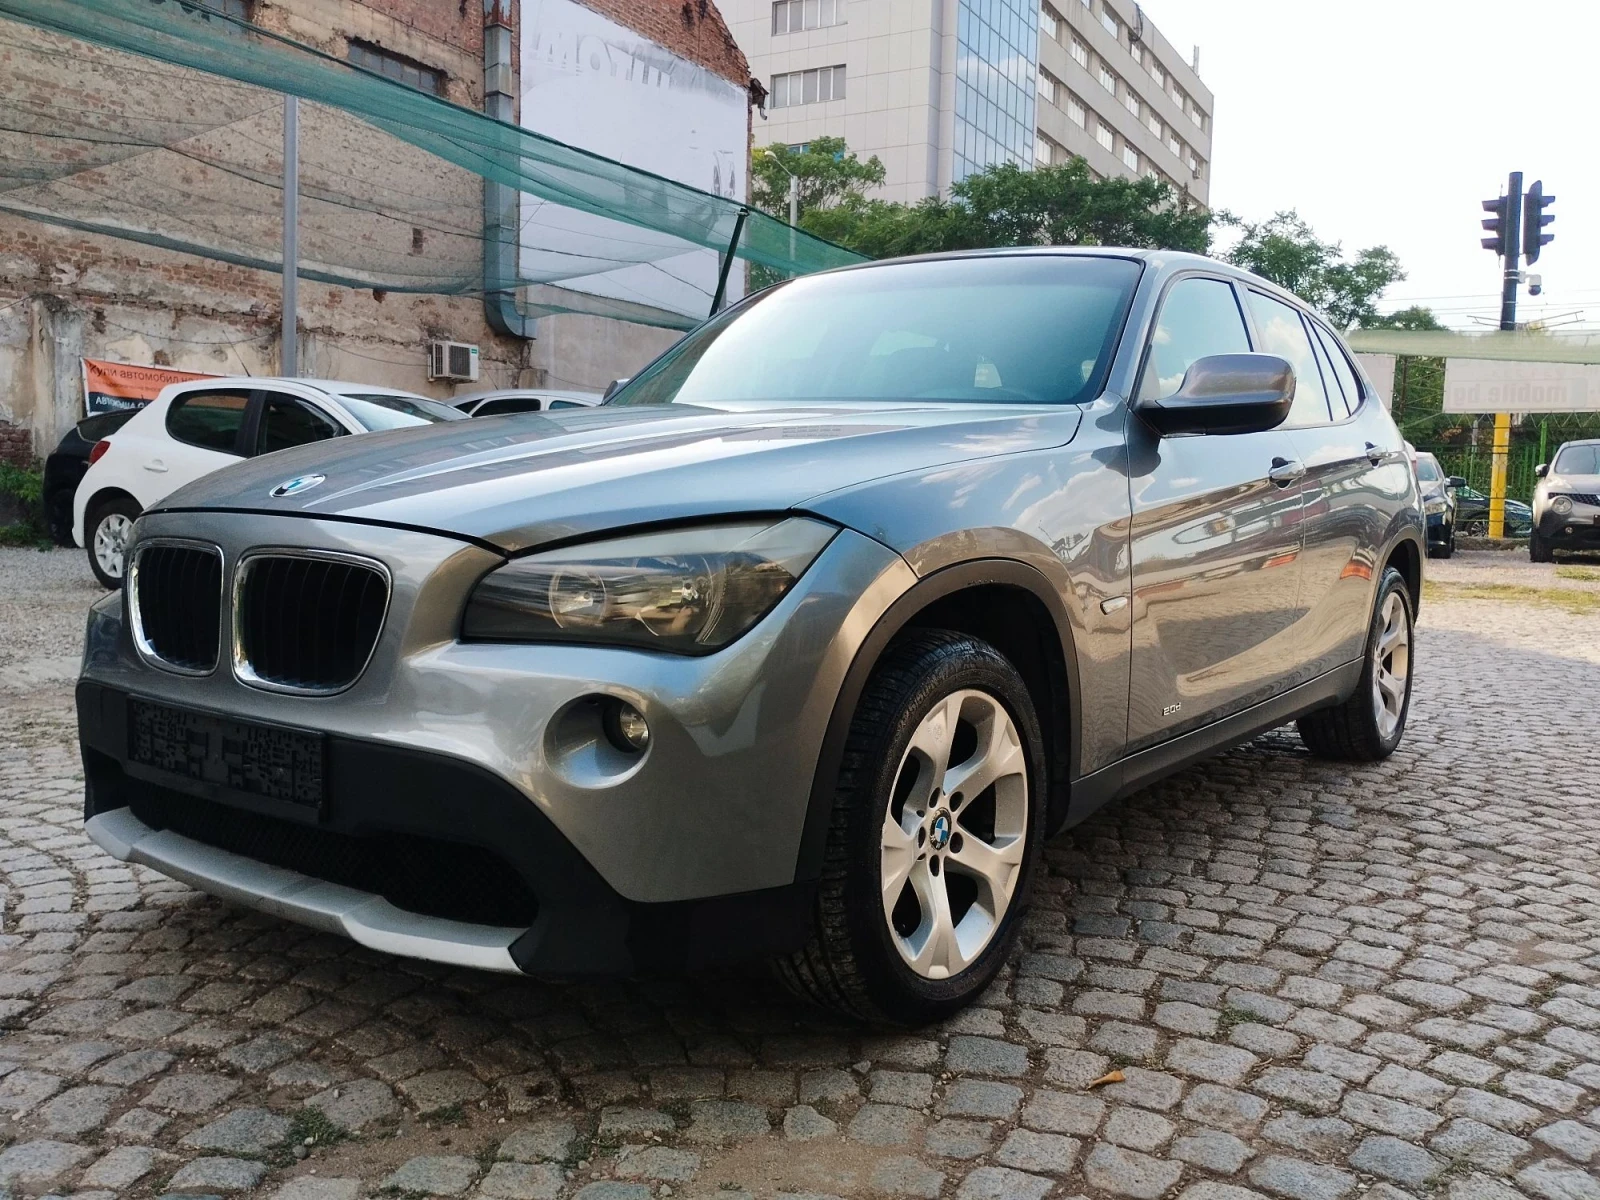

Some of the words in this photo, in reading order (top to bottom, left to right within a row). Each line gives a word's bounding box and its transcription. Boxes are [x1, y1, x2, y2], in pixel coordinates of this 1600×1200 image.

[89, 363, 117, 377] Купи
[120, 370, 179, 383] автомобил
[1162, 702, 1182, 716] 20d
